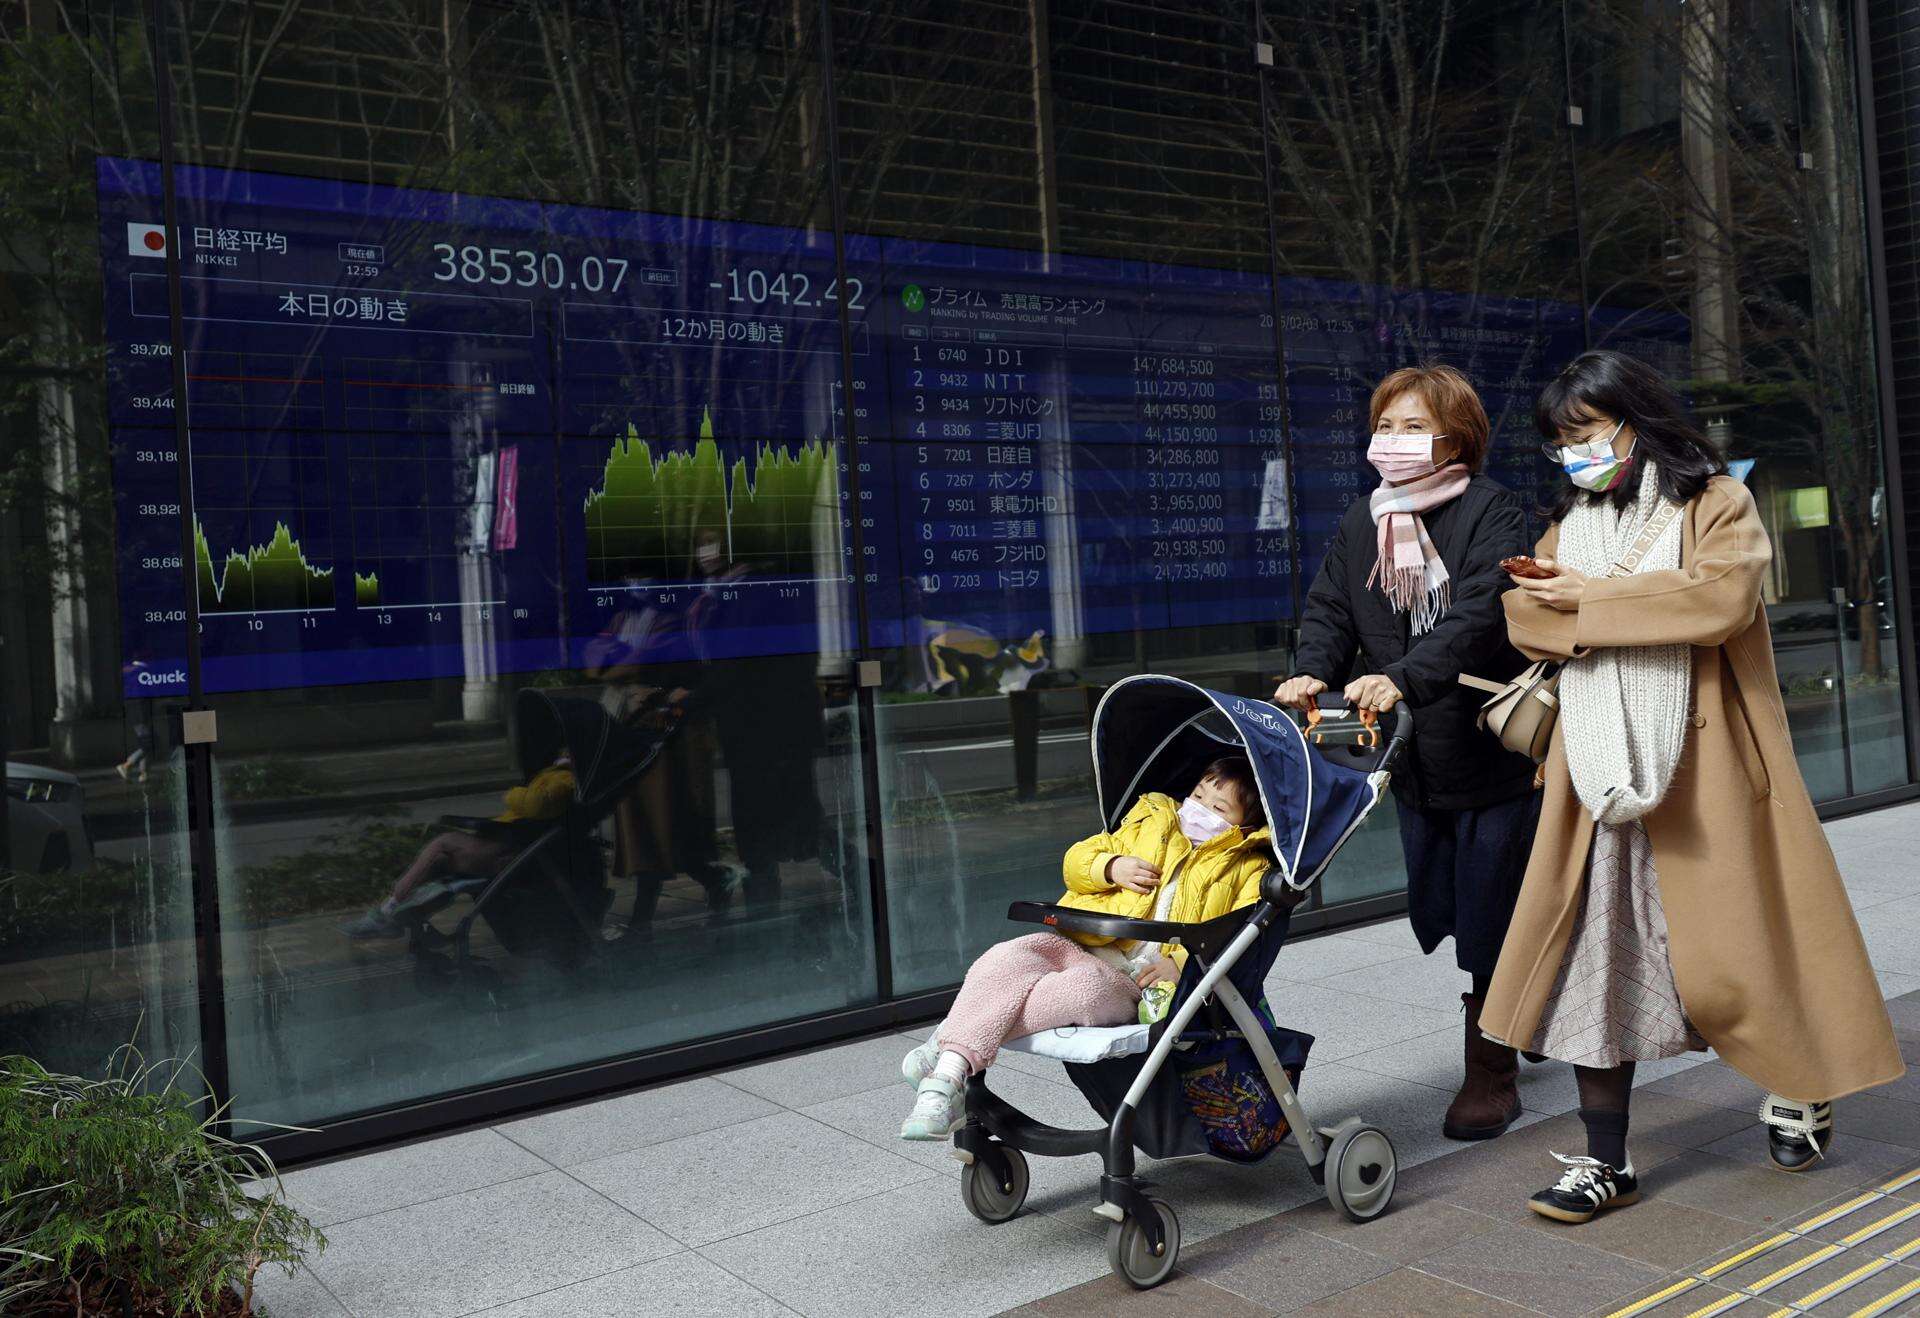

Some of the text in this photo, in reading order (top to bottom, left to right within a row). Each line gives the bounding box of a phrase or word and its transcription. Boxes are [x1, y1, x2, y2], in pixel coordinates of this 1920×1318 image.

[193, 227, 288, 255] 日経平均
[196, 254, 239, 266] NIKKEI
[433, 242, 629, 293] 38530.07
[347, 265, 379, 277] 12:59
[709, 268, 866, 310] -1042.42
[278, 291, 409, 323] 本日の動き
[930, 286, 1106, 315] プライム 売買高ランキング
[662, 318, 784, 344] 12か月の動き
[913, 345, 922, 363] 1
[938, 349, 967, 362] 6740
[1133, 356, 1215, 377] 147,684,500
[913, 370, 925, 388] 2
[939, 373, 969, 387] 9432
[984, 372, 1026, 391] NTT
[914, 395, 926, 413] 3
[941, 398, 970, 412] 9434
[984, 397, 1054, 416] ソフトバンク
[915, 421, 927, 438] 4
[943, 424, 972, 437] 8306
[984, 421, 1041, 440] 三菱UFJ
[918, 446, 929, 464] 5
[944, 449, 973, 463] 7201
[987, 446, 1032, 465] 日産自
[1328, 451, 1357, 465] -23.8
[919, 472, 930, 490] 6
[946, 474, 974, 488] 7267
[988, 470, 1034, 489] ホンダ
[1329, 472, 1359, 487] -99.5
[920, 497, 931, 515] 7
[947, 499, 976, 513] 9501
[989, 495, 1058, 514] 東電力HD
[1150, 494, 1222, 514] 3,965,000
[922, 517, 1224, 541] 8 7011 三菱重 3,400,900
[1638, 505, 1676, 547] OEWE
[923, 548, 935, 566] 9
[950, 549, 980, 563] 4676
[993, 545, 1046, 563] フジHD
[922, 573, 941, 593] 10
[951, 574, 981, 588] 7203
[998, 569, 1040, 589] トヨタ
[596, 596, 614, 607] 2/1
[659, 594, 676, 604] 5/1
[722, 591, 739, 601] 8/1
[779, 589, 800, 599] 11/1
[247, 619, 263, 632] 10
[303, 617, 317, 630] 11
[377, 614, 392, 625] 13
[427, 612, 442, 623] 14
